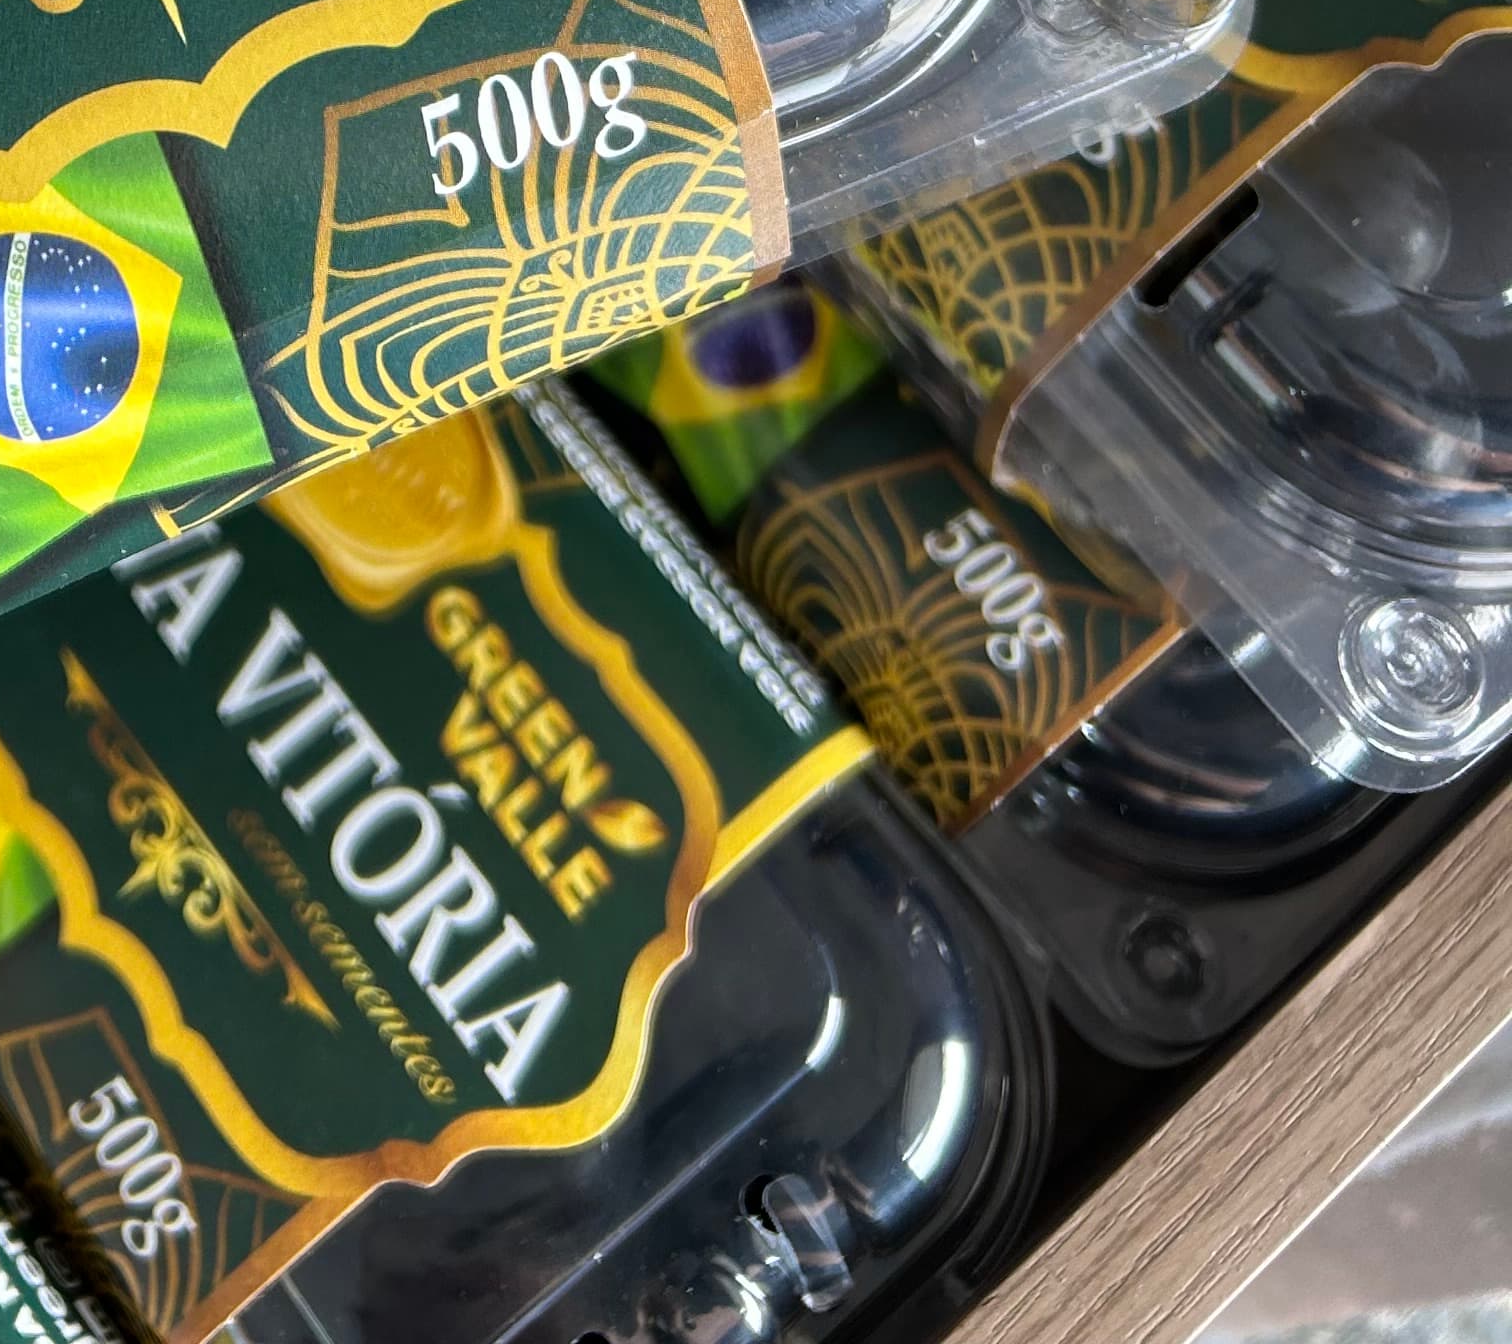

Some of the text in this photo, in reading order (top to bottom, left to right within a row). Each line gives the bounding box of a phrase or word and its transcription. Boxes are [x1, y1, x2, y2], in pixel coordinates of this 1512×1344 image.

[420, 50, 648, 196] 500g
[6, 239, 27, 358] PROGRESSO
[8, 384, 34, 437] ORDEM
[923, 508, 1066, 672] 500g
[425, 584, 612, 812] GREEN
[216, 607, 571, 1105] VITÓRIA
[441, 689, 614, 924] VALLE
[292, 900, 458, 1105] sementes
[68, 1074, 198, 1258] 500g
